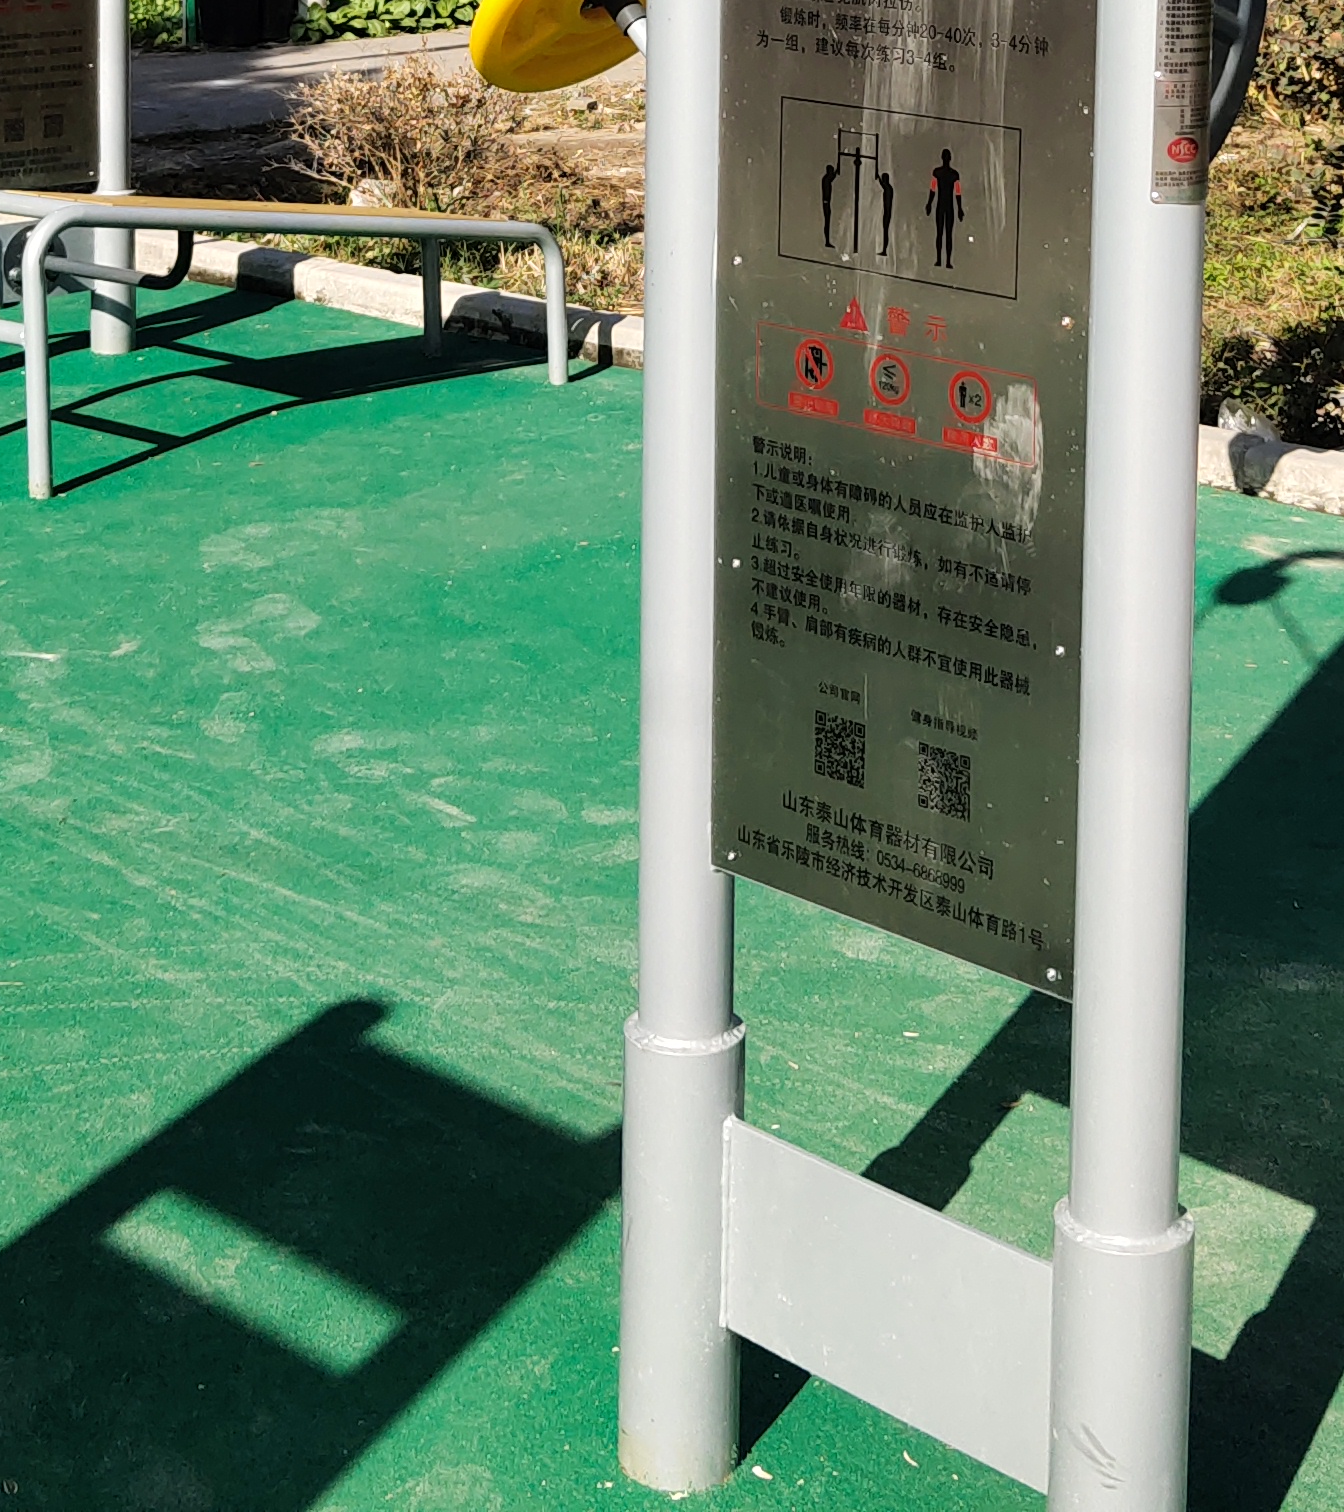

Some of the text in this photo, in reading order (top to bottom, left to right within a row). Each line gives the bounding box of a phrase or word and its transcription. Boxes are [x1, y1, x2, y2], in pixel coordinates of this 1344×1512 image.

[752, 434, 814, 467] 警示说明：
[782, 789, 995, 881] 山东泰山体育器材有限公司
[737, 824, 1045, 952] 山东省乐陵市经济技术开发区泰山体育路1号
